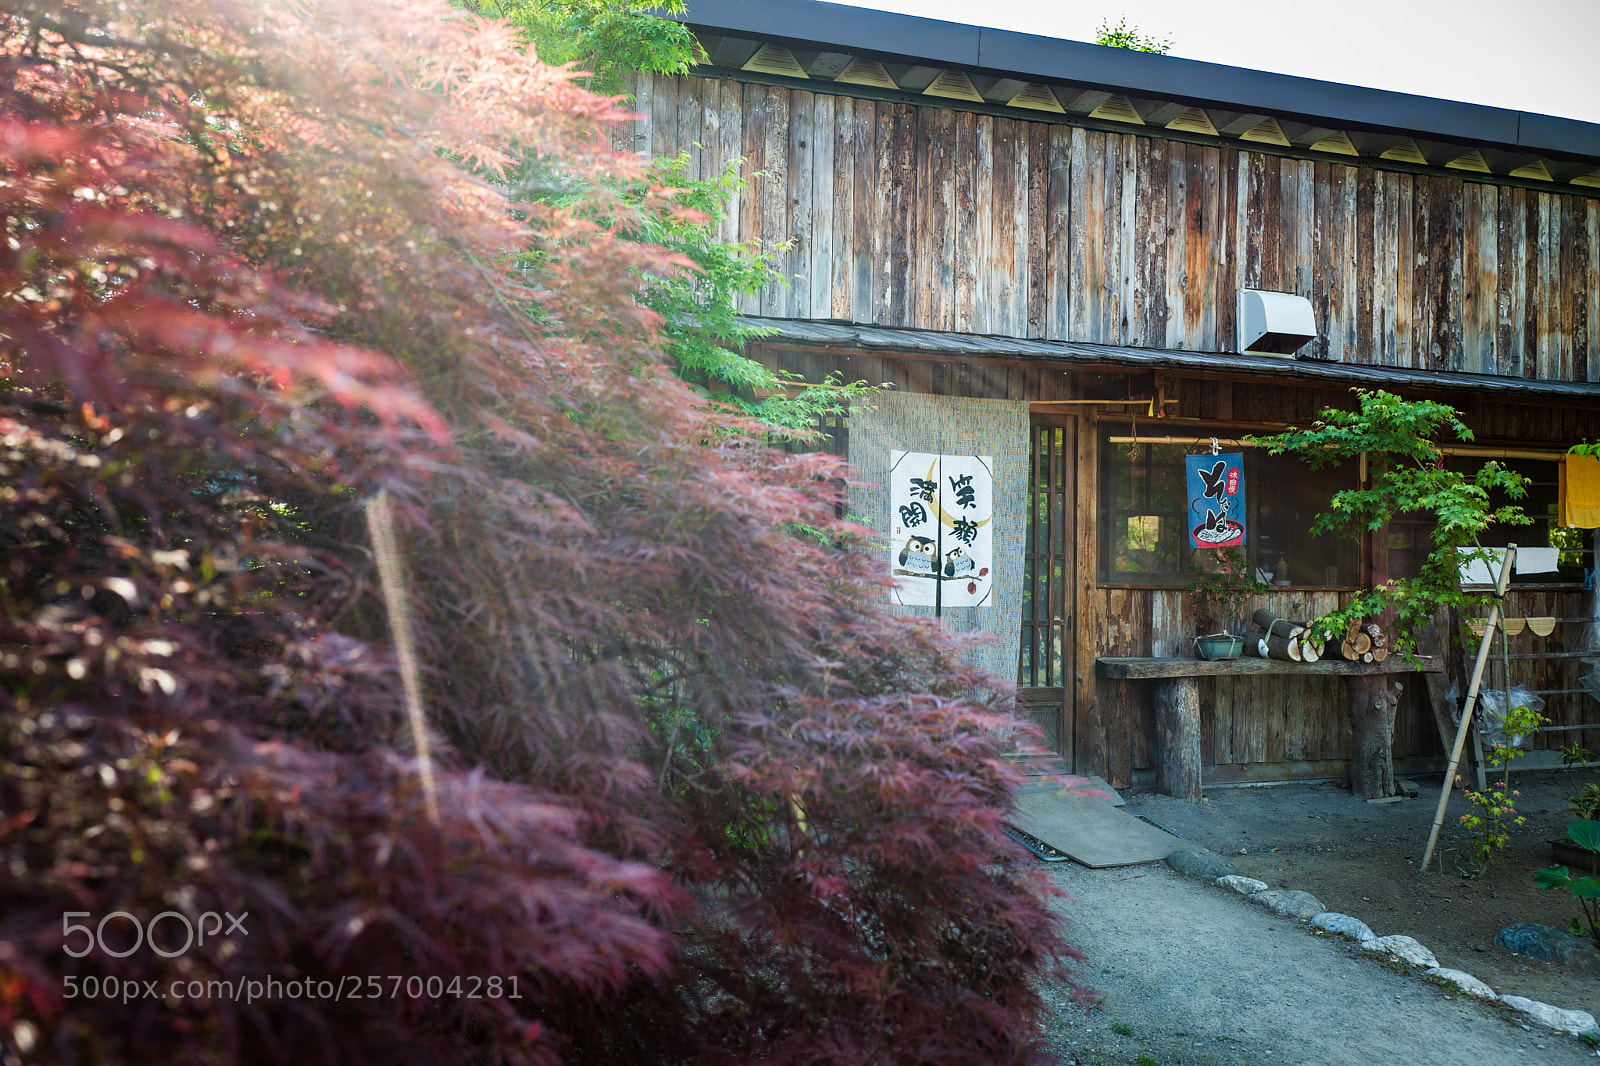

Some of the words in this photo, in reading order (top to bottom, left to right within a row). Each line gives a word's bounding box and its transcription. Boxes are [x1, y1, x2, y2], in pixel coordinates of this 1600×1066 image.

[898, 477, 939, 528] 満開
[948, 473, 979, 547] 笑顔
[1197, 460, 1231, 533] そば
